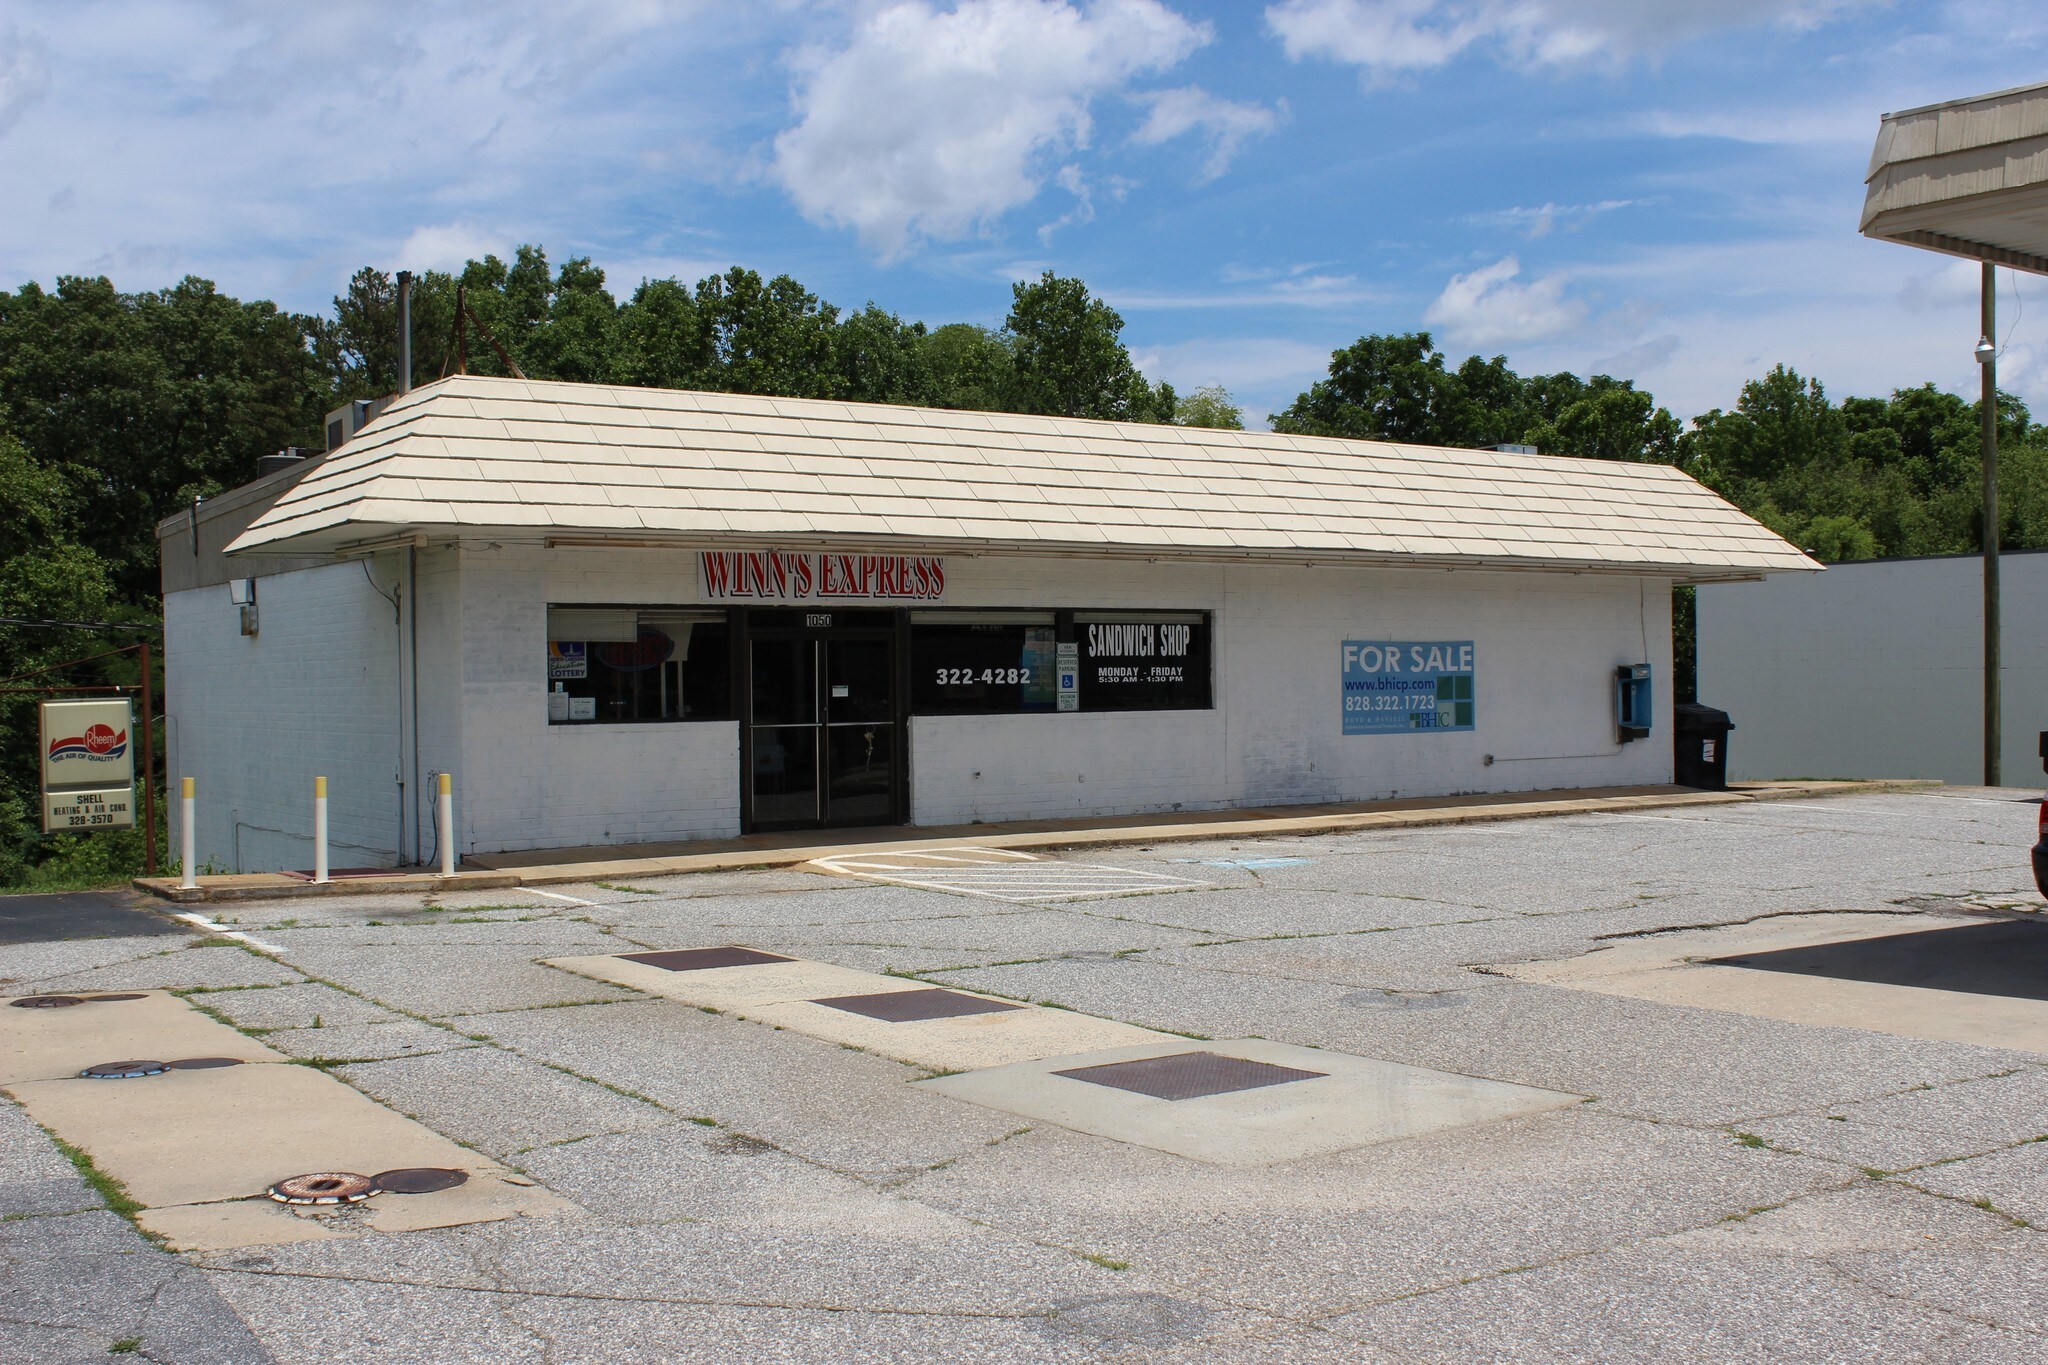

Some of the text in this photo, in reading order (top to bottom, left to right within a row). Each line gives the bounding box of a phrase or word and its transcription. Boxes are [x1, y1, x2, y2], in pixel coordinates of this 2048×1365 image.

[702, 552, 944, 599] WINN'S EXPRESS
[807, 614, 831, 627] 1050
[1088, 624, 1154, 657] SANDWICH
[1160, 624, 1190, 656] SHOP
[551, 661, 585, 670] Education
[1344, 646, 1472, 672] FOR SALE
[936, 668, 1030, 684] 322-4282
[1098, 667, 1139, 677] MONDAY
[1151, 667, 1183, 676] FRIDAY
[1345, 677, 1435, 693] www.bhicp.com
[1345, 695, 1435, 711] 828.322.1723
[1421, 712, 1449, 727] BHIC
[86, 725, 114, 748] Rheem
[52, 755, 64, 763] THE
[77, 794, 103, 804] SHELL
[54, 806, 80, 815] HEATING
[95, 804, 105, 813] AIR
[69, 814, 113, 825] 328-3570
